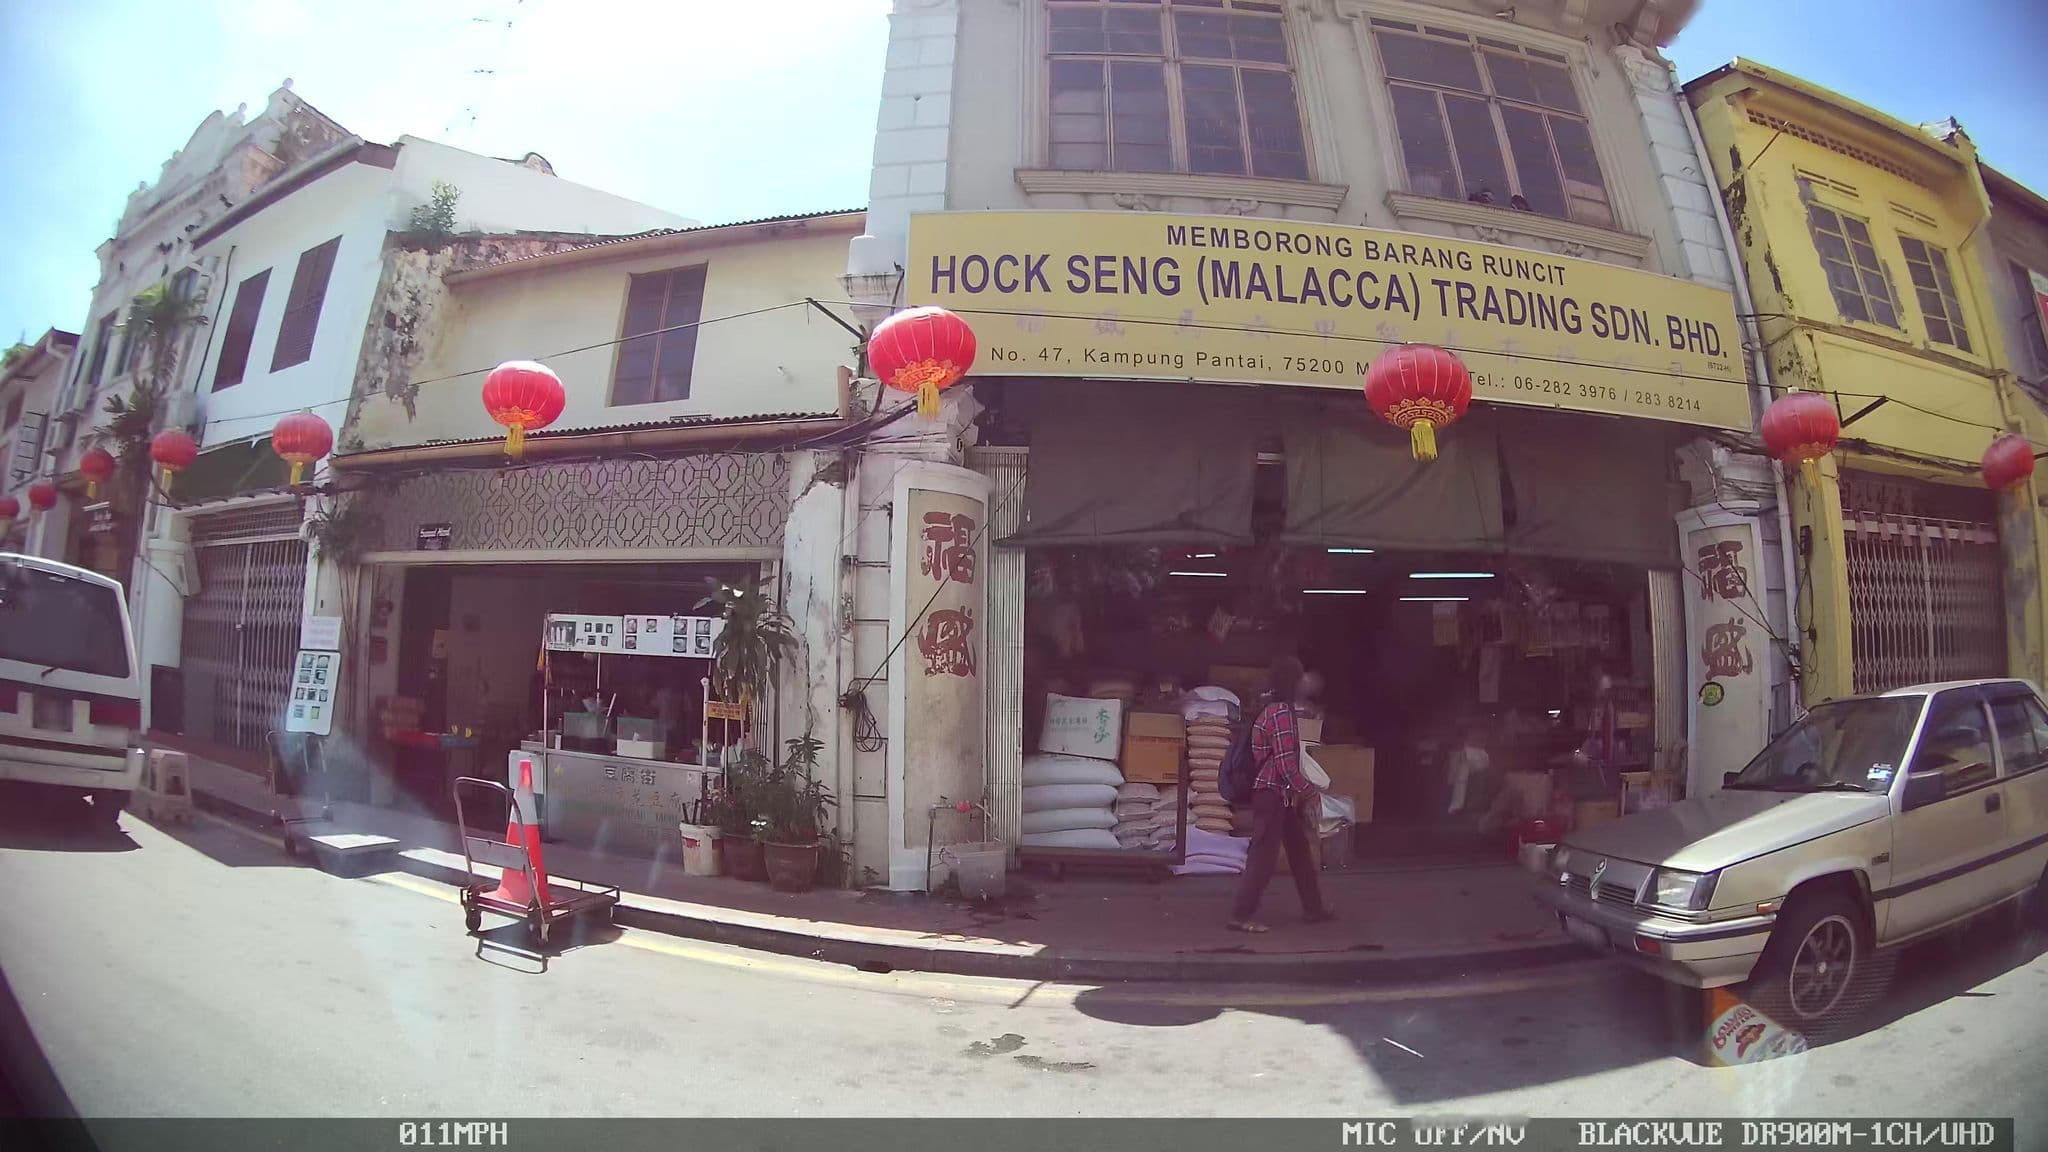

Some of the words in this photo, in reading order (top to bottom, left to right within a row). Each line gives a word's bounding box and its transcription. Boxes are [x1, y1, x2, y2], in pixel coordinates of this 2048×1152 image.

[1166, 224, 1353, 259] MEMBORONG
[1364, 239, 1473, 272] BARANG
[1481, 254, 1567, 286] RUNCIT
[931, 253, 1052, 295] HOCK
[1066, 254, 1181, 297] SENG
[1196, 255, 1421, 322] (MALACCA)
[1430, 278, 1583, 335] TRADING
[1590, 301, 1661, 347] SDN.
[1665, 314, 1730, 359] BHD.
[990, 346, 1026, 362] No.
[1038, 347, 1073, 365] 47,
[1083, 347, 1186, 370] Kampung
[1196, 351, 1274, 373] Pantai,
[1282, 356, 1344, 375] 75200
[1467, 370, 1507, 389] Tel.:
[1514, 375, 1571, 397] 06-282
[1578, 383, 1617, 401] 3976
[1623, 389, 1629, 403] /
[1635, 390, 1661, 407] 283
[1668, 395, 1702, 412] 8214
[918, 511, 977, 678] 福盛
[1697, 540, 1754, 682] 福盛
